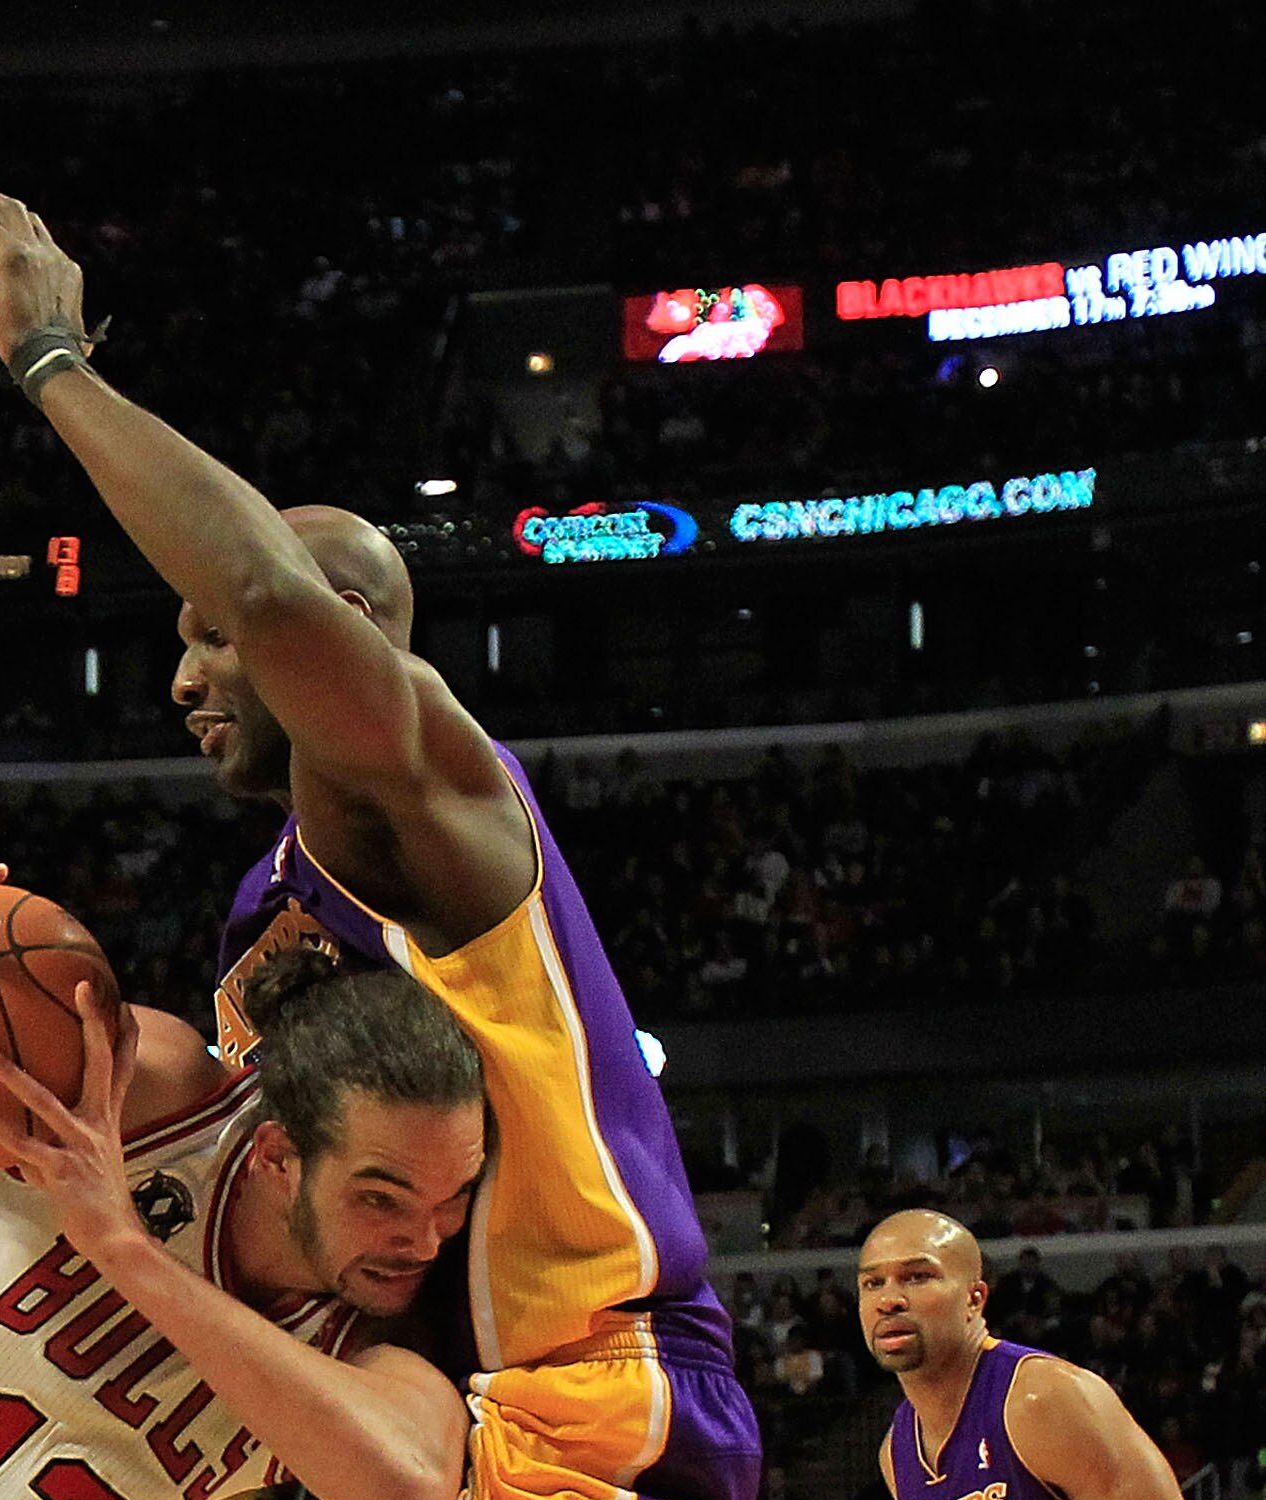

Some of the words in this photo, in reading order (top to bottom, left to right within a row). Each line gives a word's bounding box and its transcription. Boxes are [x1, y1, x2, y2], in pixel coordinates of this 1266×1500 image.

[836, 261, 1066, 321] BLACKHAWKS
[1107, 246, 1178, 293] RED
[730, 467, 1097, 543] CSNCHICAGO.COM
